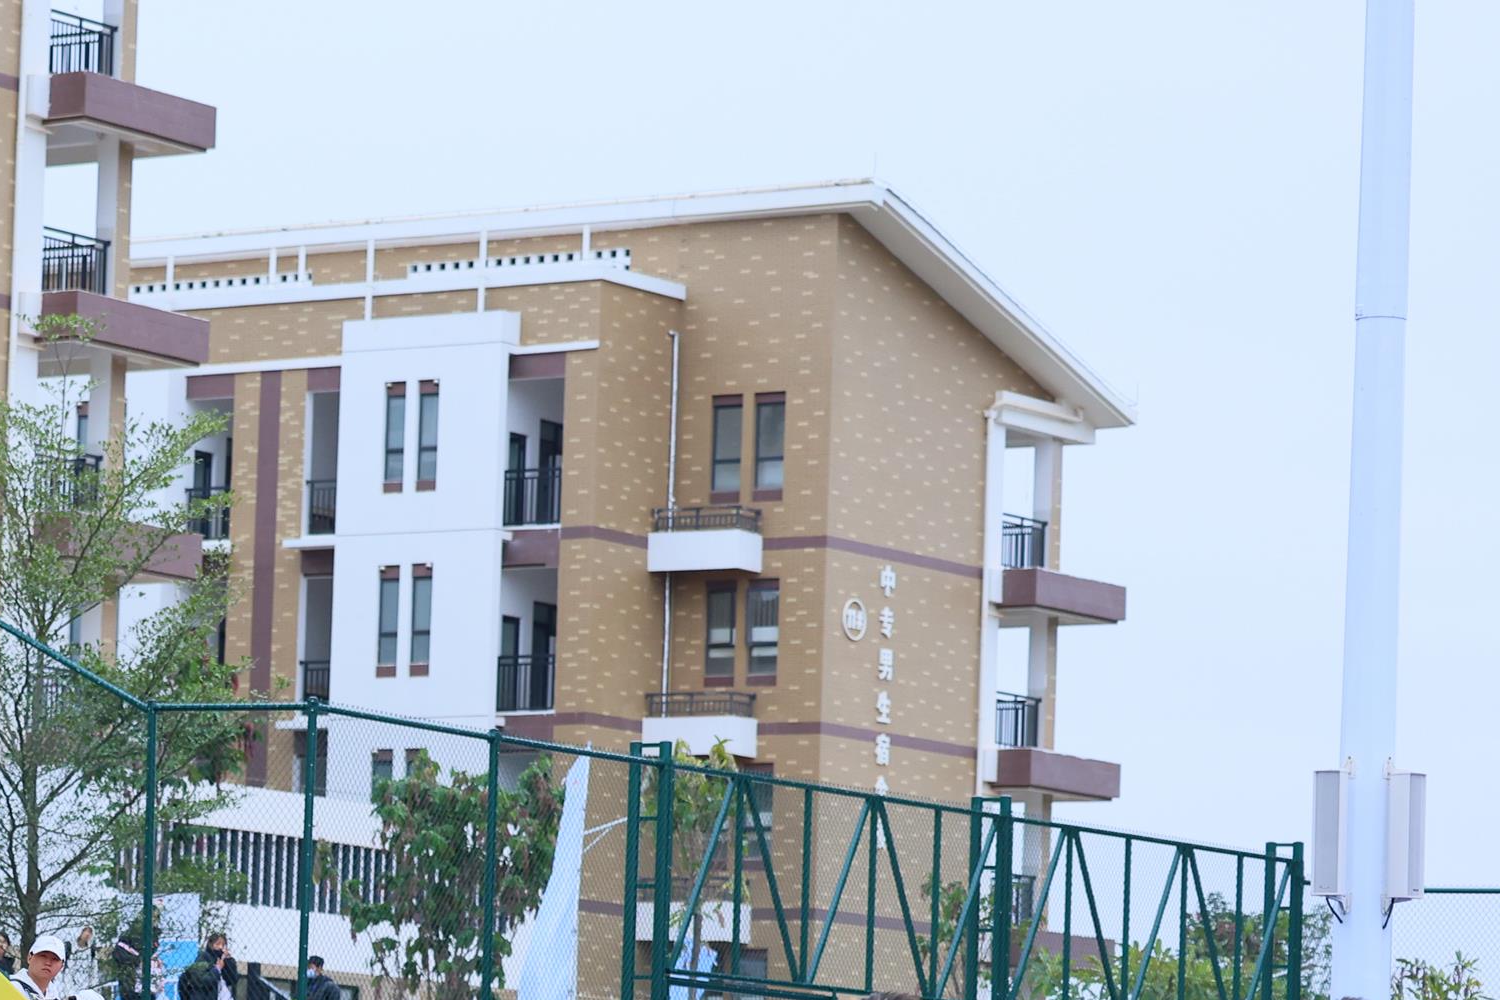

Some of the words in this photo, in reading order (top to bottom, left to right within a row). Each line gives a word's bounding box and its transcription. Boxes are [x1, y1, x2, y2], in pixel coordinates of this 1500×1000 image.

[874, 564, 897, 850] 中专男生宿舍
